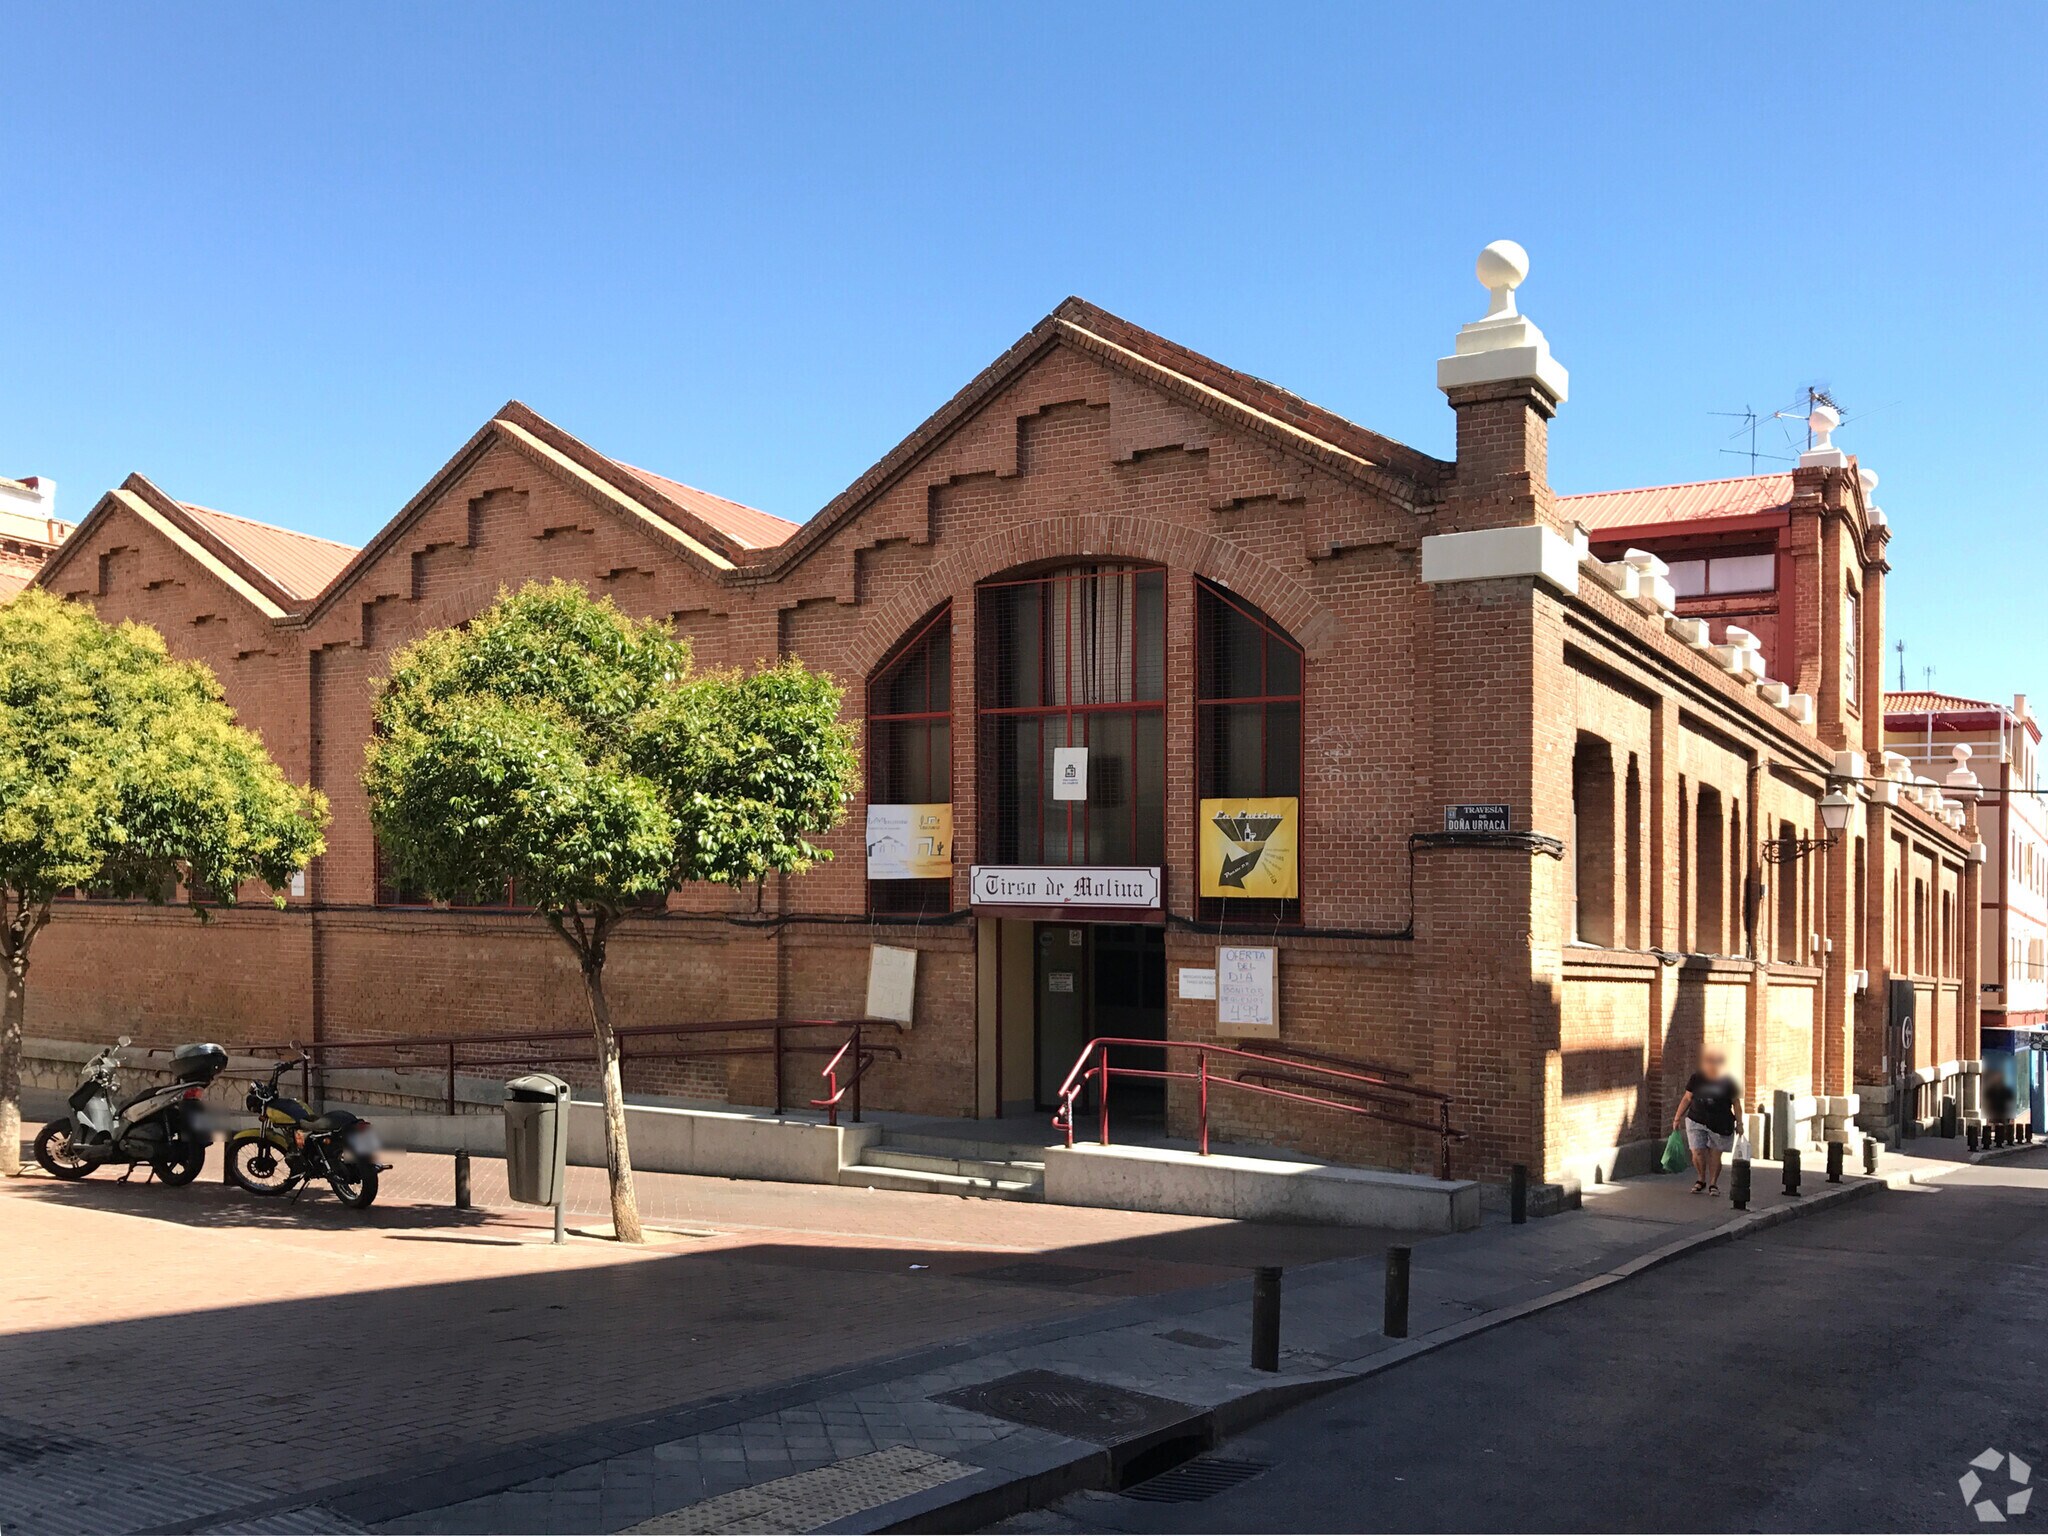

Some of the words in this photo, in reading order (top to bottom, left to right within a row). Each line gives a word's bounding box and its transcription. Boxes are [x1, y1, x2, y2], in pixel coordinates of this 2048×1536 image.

[1448, 818, 1470, 830] DOÑA
[1472, 819, 1506, 830] URRACA
[985, 875, 1036, 896] Tirso
[1045, 876, 1065, 896] de
[1073, 876, 1143, 898] Molina
[1226, 950, 1266, 961] OFERTA
[1237, 962, 1256, 970] DEL
